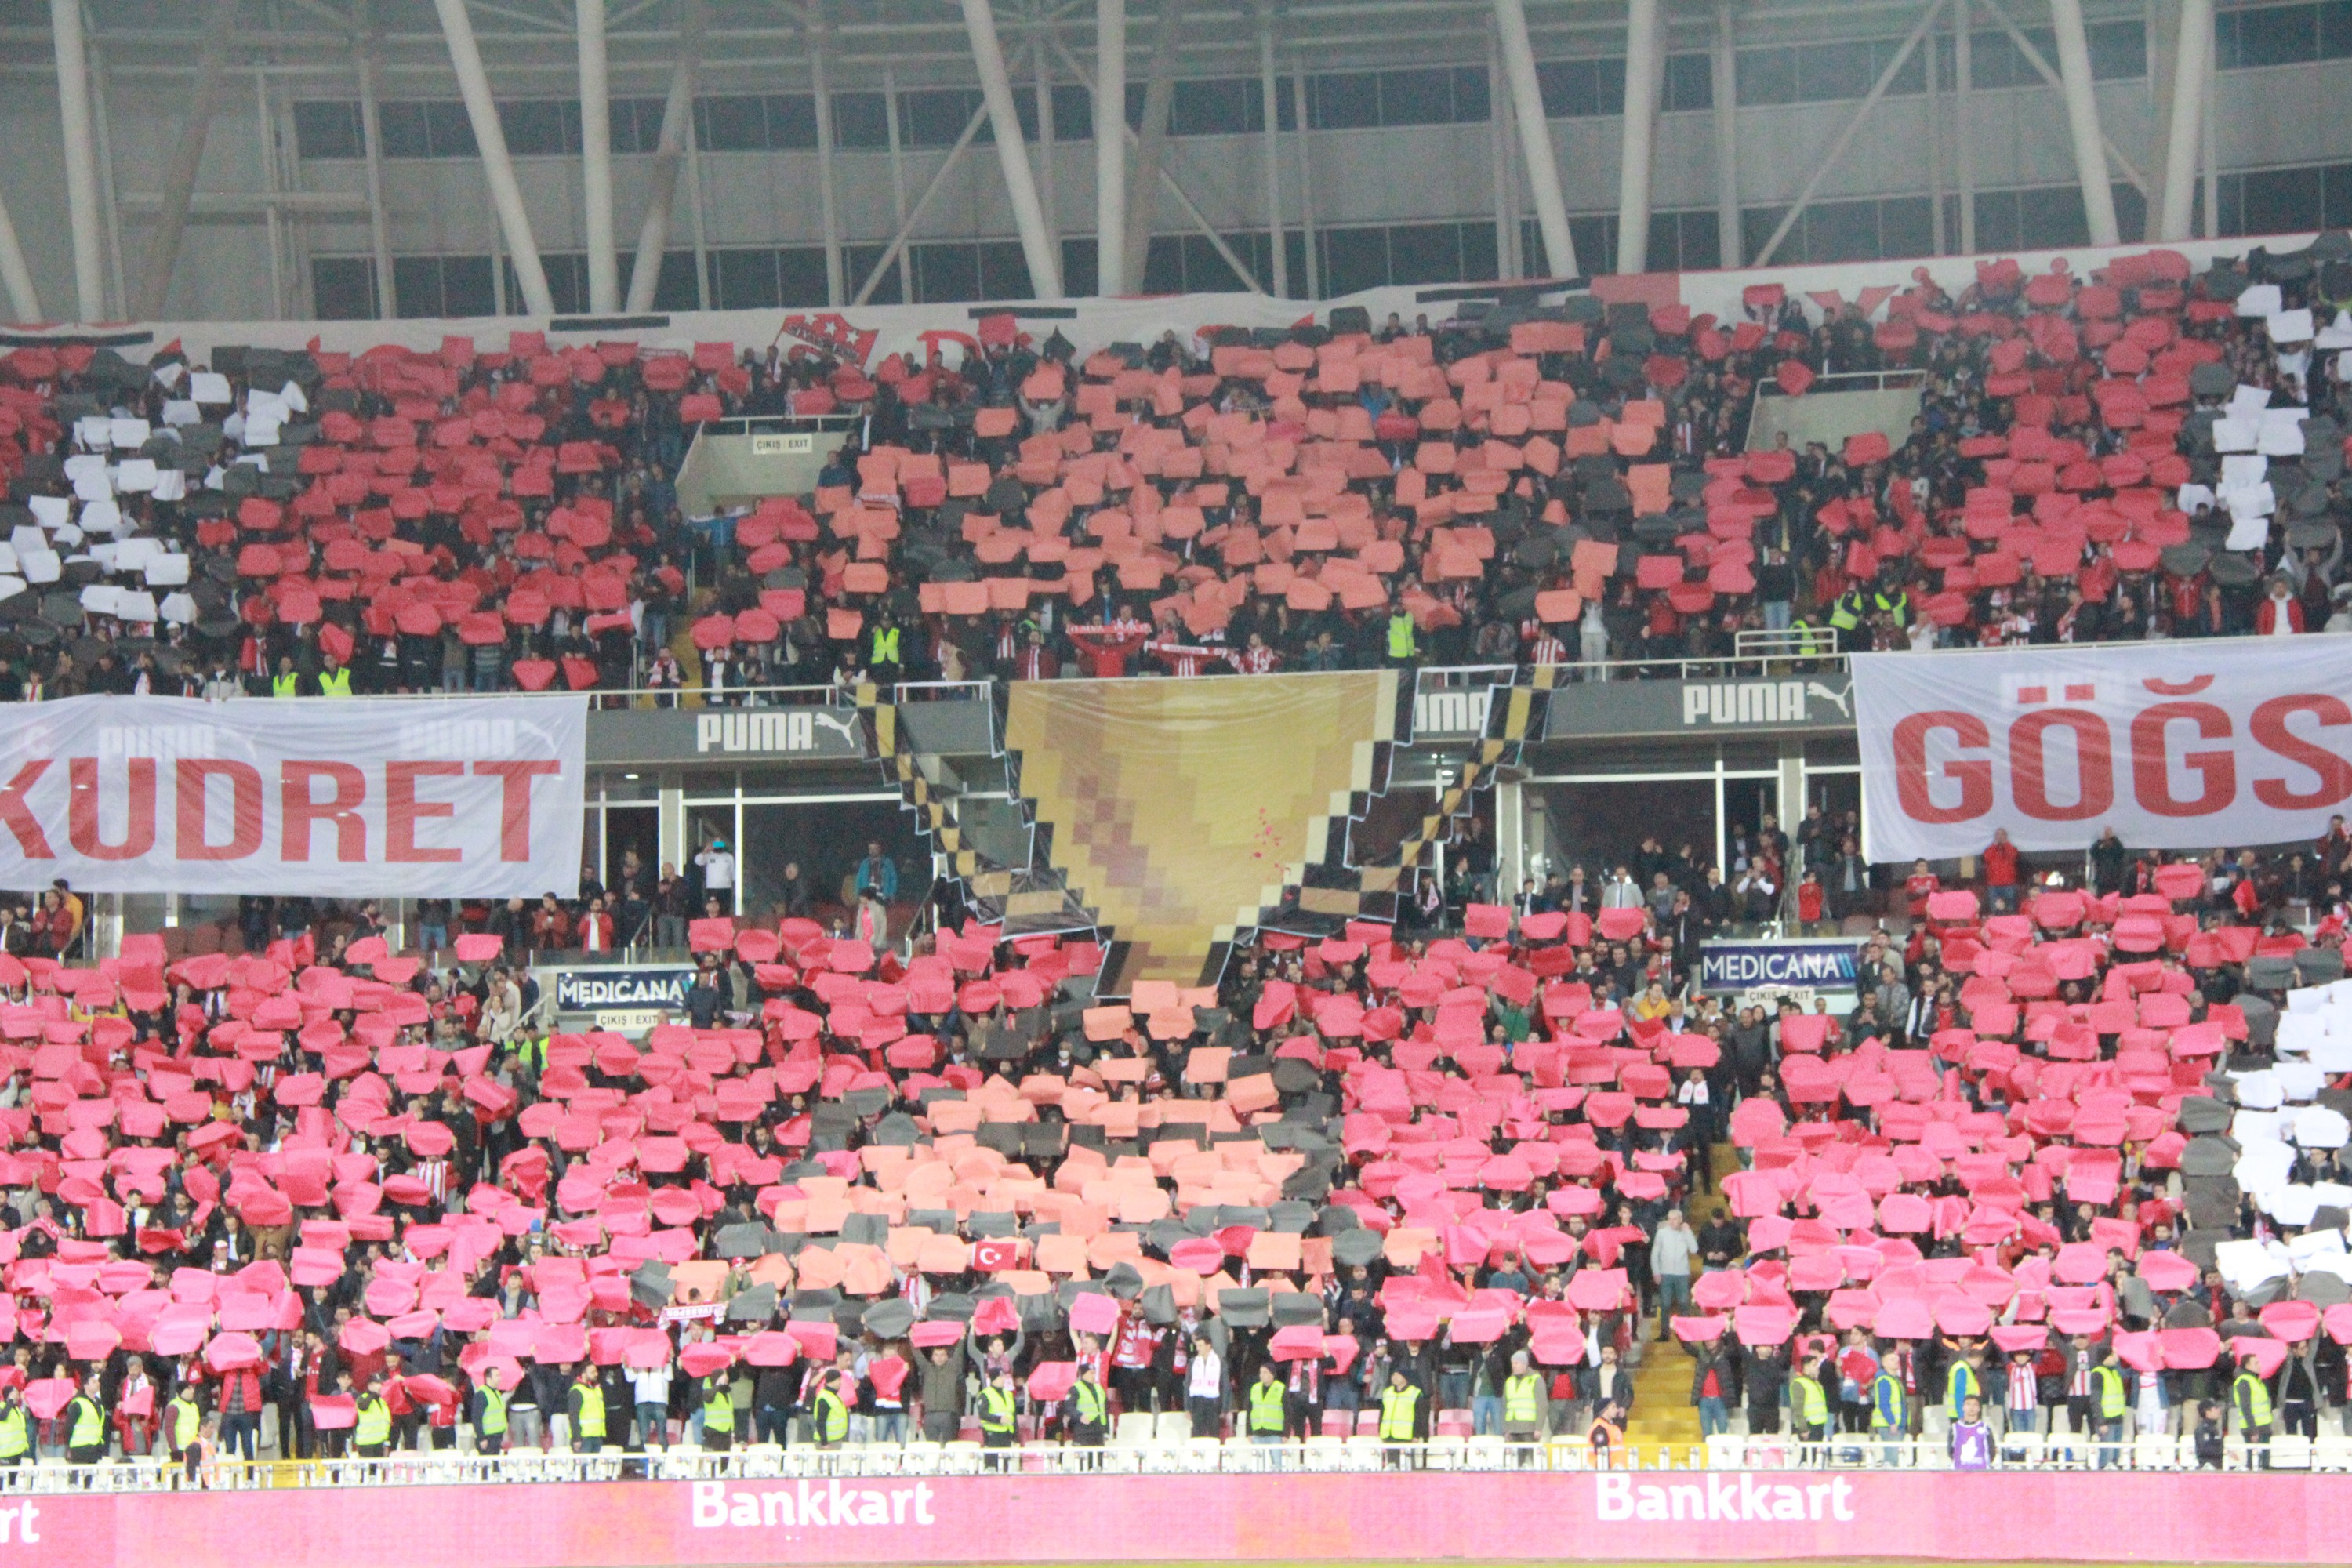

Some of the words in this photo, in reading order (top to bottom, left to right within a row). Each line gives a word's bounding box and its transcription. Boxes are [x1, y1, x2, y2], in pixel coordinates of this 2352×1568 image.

[789, 439, 809, 448] EXIT
[1683, 681, 1804, 724] PUMA
[697, 712, 812, 752] PUMA
[1893, 674, 2352, 824] GÖĞS
[0, 757, 561, 862] KUDRET
[1703, 953, 1840, 981] MEDICANA
[558, 980, 684, 1003] MEDICANA
[1787, 990, 1810, 1000] EXIT
[601, 1014, 627, 1025] ÇIKIŞ
[636, 1014, 658, 1025] EXIT
[692, 1479, 935, 1527] Bankkart
[1596, 1472, 1854, 1521] Bankkart
